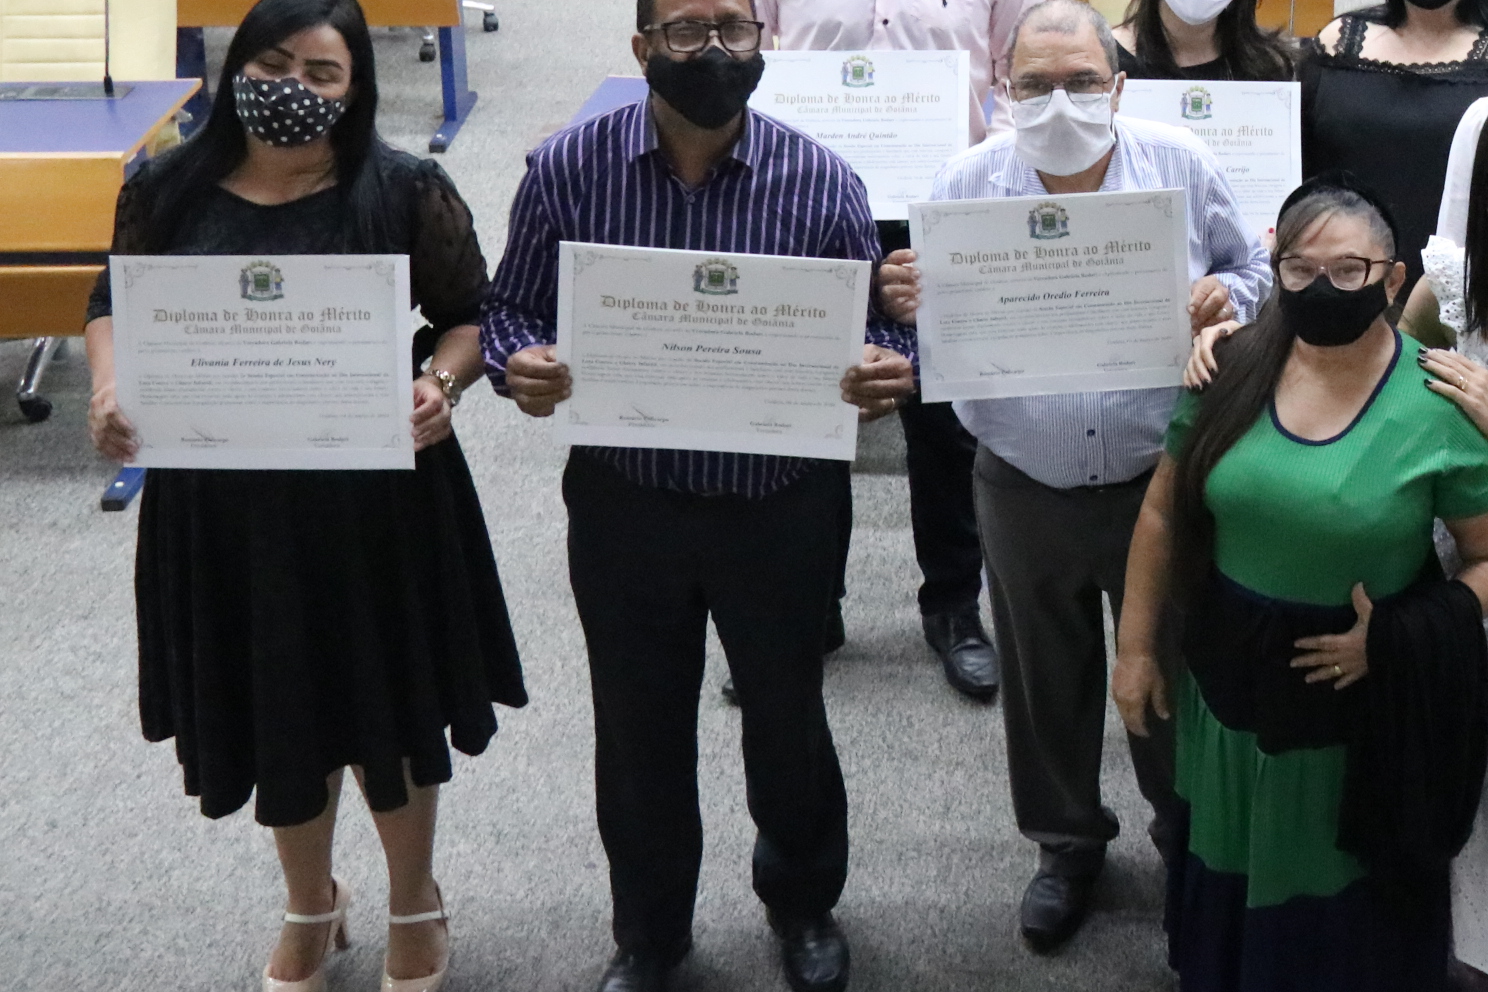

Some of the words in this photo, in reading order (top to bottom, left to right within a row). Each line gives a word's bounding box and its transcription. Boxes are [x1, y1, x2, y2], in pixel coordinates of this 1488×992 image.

[774, 93, 823, 105] Diploma
[827, 93, 839, 104] de
[843, 92, 881, 104] Honra
[902, 92, 941, 104] Mérito
[796, 105, 829, 114] Câmara
[831, 105, 872, 114] Municipal
[874, 105, 883, 113] de
[885, 105, 918, 113] Goiânia
[869, 132, 898, 140] Quintão
[1237, 125, 1273, 137] Mérito
[1224, 139, 1252, 147] Goiânia
[949, 251, 1010, 267] Diploma
[1014, 249, 1029, 261] de
[1034, 245, 1079, 260] Honra
[1083, 245, 1098, 256] ao
[1103, 240, 1152, 256] Mérito
[978, 263, 1017, 275] Câmara
[1020, 260, 1069, 273] Municipal
[1073, 258, 1082, 268] de
[1085, 256, 1124, 267] Goiânia
[997, 293, 1041, 305] Aparecido
[1043, 290, 1072, 300] Oredio
[1074, 288, 1110, 298] Ferreira
[600, 295, 669, 312] Diploma
[673, 299, 689, 312] de
[695, 299, 746, 316] Honra
[751, 304, 768, 316] ao
[773, 303, 827, 319] Mérito
[153, 308, 220, 322] Diploma
[223, 308, 239, 322] de
[243, 308, 293, 322] Honra
[298, 311, 314, 321] ao
[319, 307, 371, 322] Mérito
[632, 312, 675, 322] Câmara
[678, 314, 733, 326] Municipal
[736, 316, 749, 326] de
[751, 317, 795, 328] Goiânia
[183, 324, 226, 335] Câmara
[229, 324, 282, 335] Municipal
[286, 324, 298, 334] de
[300, 323, 342, 334] Goiânia
[662, 342, 692, 352] Nilson
[696, 344, 730, 354] Pereira
[733, 345, 762, 355] Sousa
[191, 358, 229, 367] Elivania
[232, 358, 271, 367] Ferreira
[273, 358, 285, 367] de
[287, 358, 311, 367] Jesus
[313, 358, 337, 368] Nery
